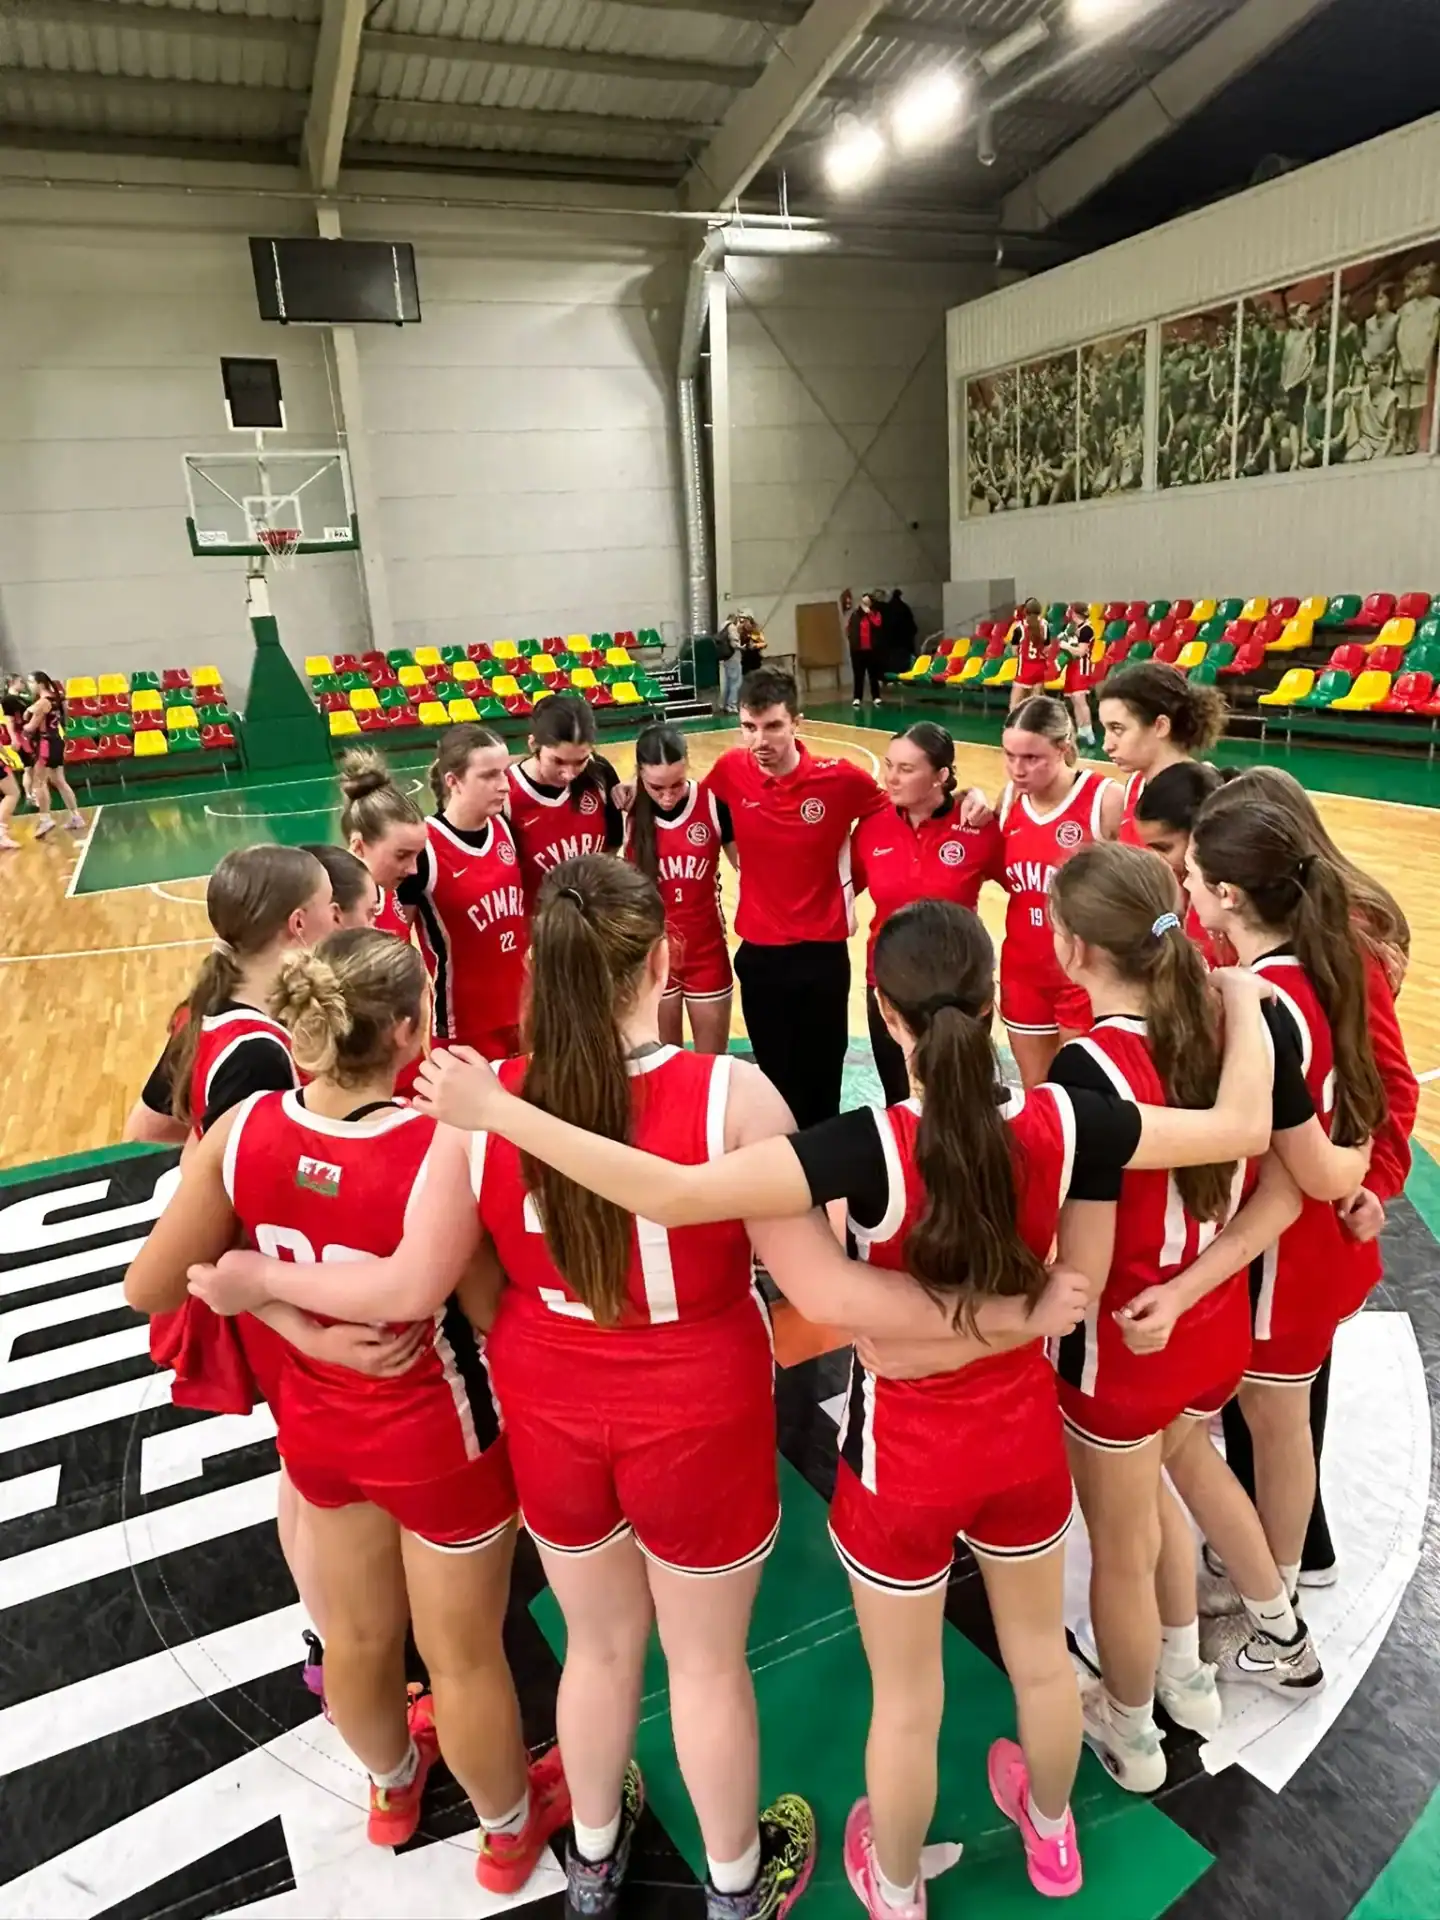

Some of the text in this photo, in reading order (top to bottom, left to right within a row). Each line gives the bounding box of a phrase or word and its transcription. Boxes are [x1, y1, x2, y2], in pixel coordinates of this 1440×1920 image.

[656, 855, 710, 882] YMRU
[1006, 861, 1058, 893] CYMR
[674, 887, 683, 903] 3
[1028, 907, 1043, 927] 19
[499, 930, 518, 953] 22
